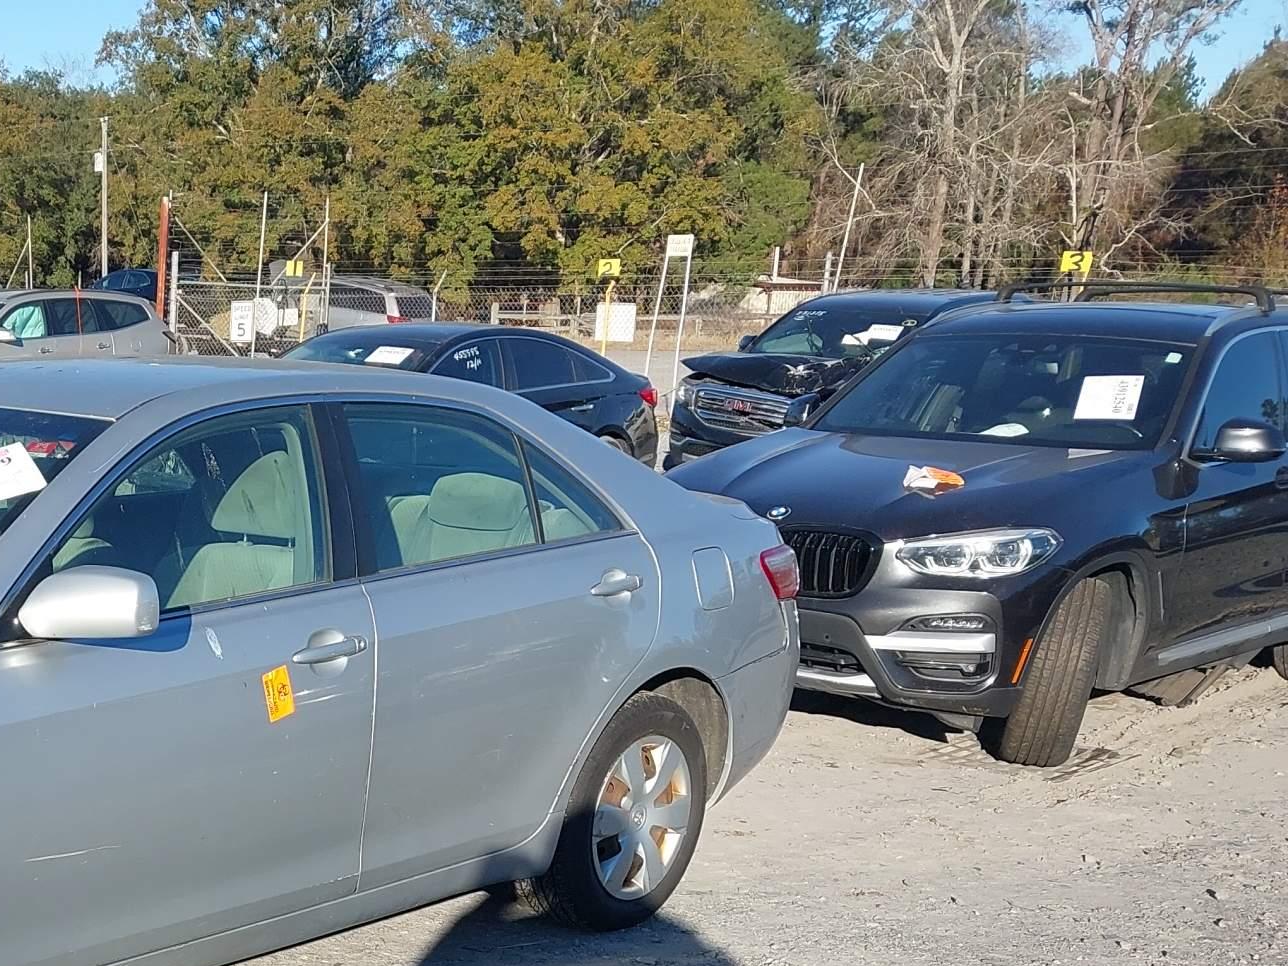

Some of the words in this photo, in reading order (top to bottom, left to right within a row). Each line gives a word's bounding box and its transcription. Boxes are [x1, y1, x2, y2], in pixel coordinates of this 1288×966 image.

[601, 261, 615, 277] 2
[1068, 253, 1085, 271] 3
[237, 322, 246, 337] 5
[724, 398, 753, 413] GMC
